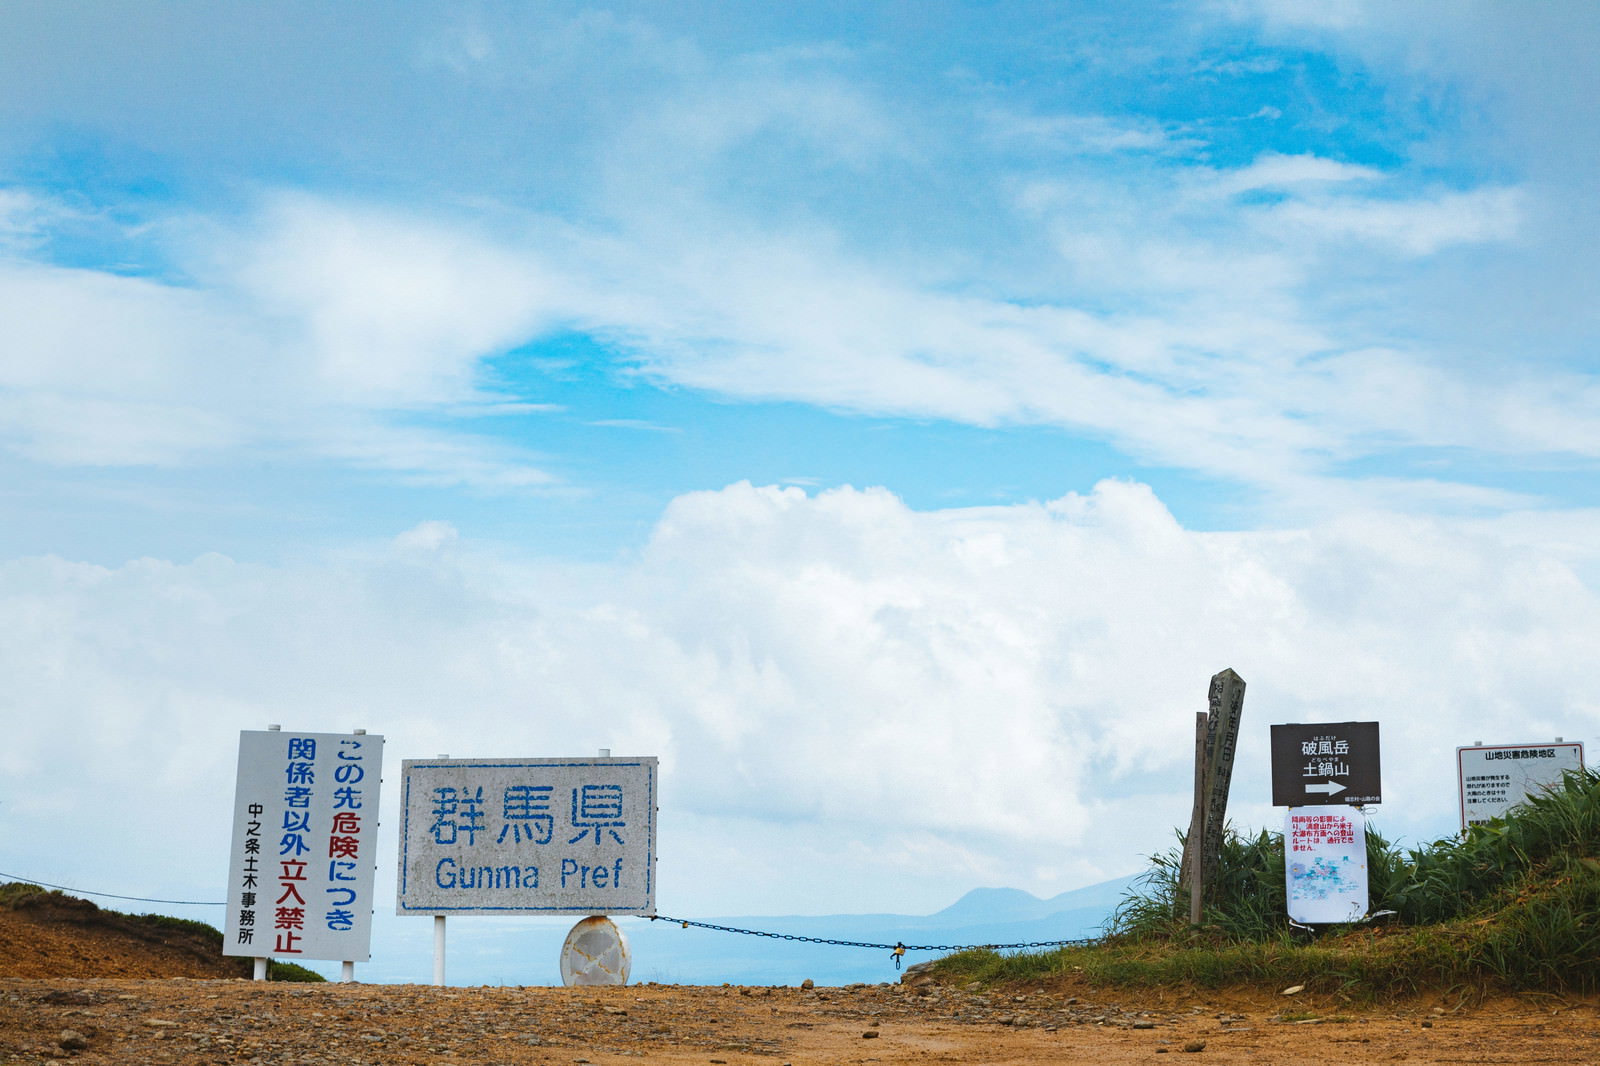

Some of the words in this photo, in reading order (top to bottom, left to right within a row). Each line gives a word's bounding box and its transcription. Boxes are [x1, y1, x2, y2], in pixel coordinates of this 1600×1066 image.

[1301, 740, 1350, 755] 破風岳
[1302, 762, 1350, 777] 土鍋山
[1485, 749, 1556, 760] 山地災害危険地区
[325, 740, 364, 931] この先危険につき
[429, 785, 626, 846] 群馬県
[273, 738, 317, 954] 関係者以外立入禁止
[238, 803, 263, 945] 中之条土木事務所
[435, 858, 539, 889] Gunma
[561, 858, 623, 889] Pref
